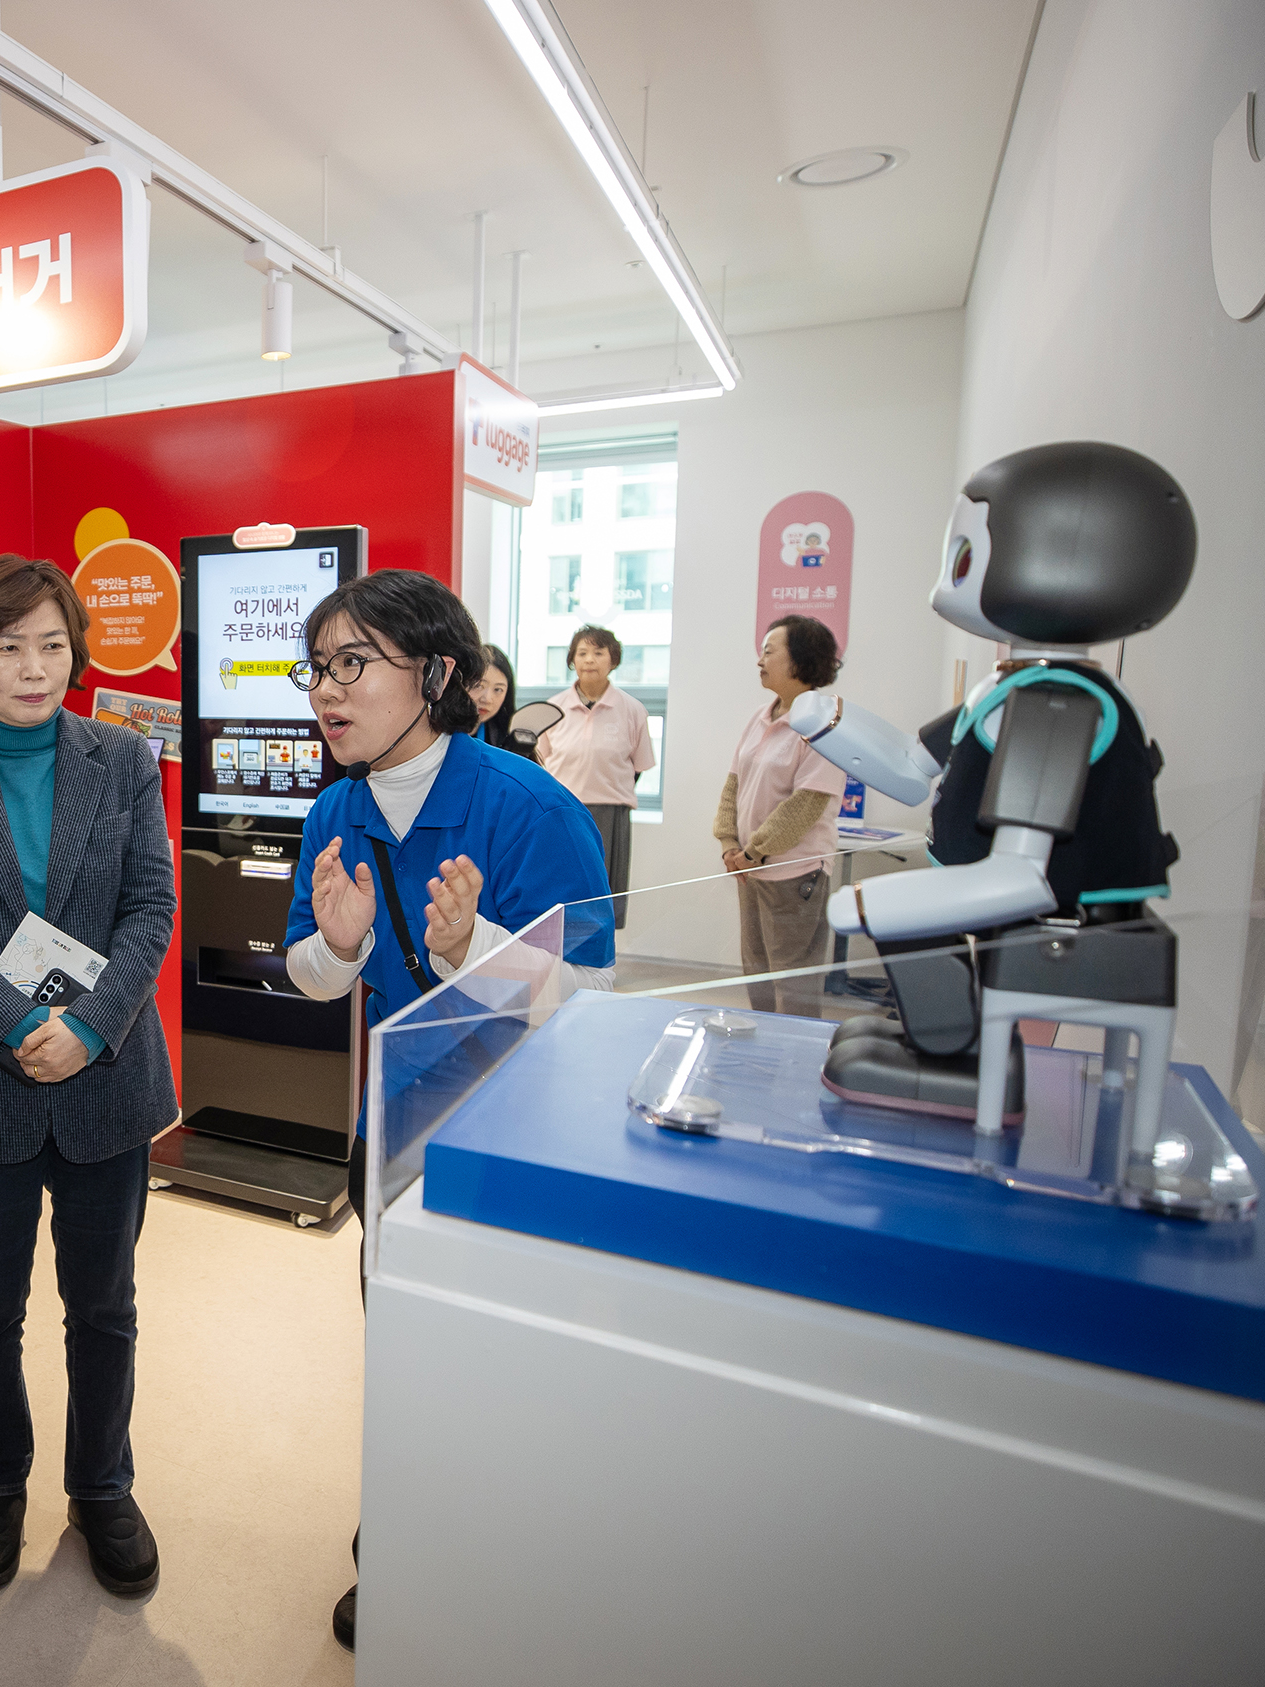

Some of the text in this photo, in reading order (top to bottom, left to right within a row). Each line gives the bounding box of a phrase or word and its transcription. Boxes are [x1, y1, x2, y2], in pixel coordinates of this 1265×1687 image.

[130, 575, 155, 590] 주문,
[230, 583, 308, 595] 기다리지 않고 간편하게
[772, 585, 838, 600] 디지털 소통
[86, 595, 98, 608] 내
[99, 593, 130, 607] 손으로
[234, 597, 299, 618] 여기에서
[774, 602, 835, 610] Communication
[222, 622, 305, 642] 주문하세요
[239, 663, 255, 673] 화면
[256, 662, 280, 672] 터치해
[130, 703, 154, 721] Hot
